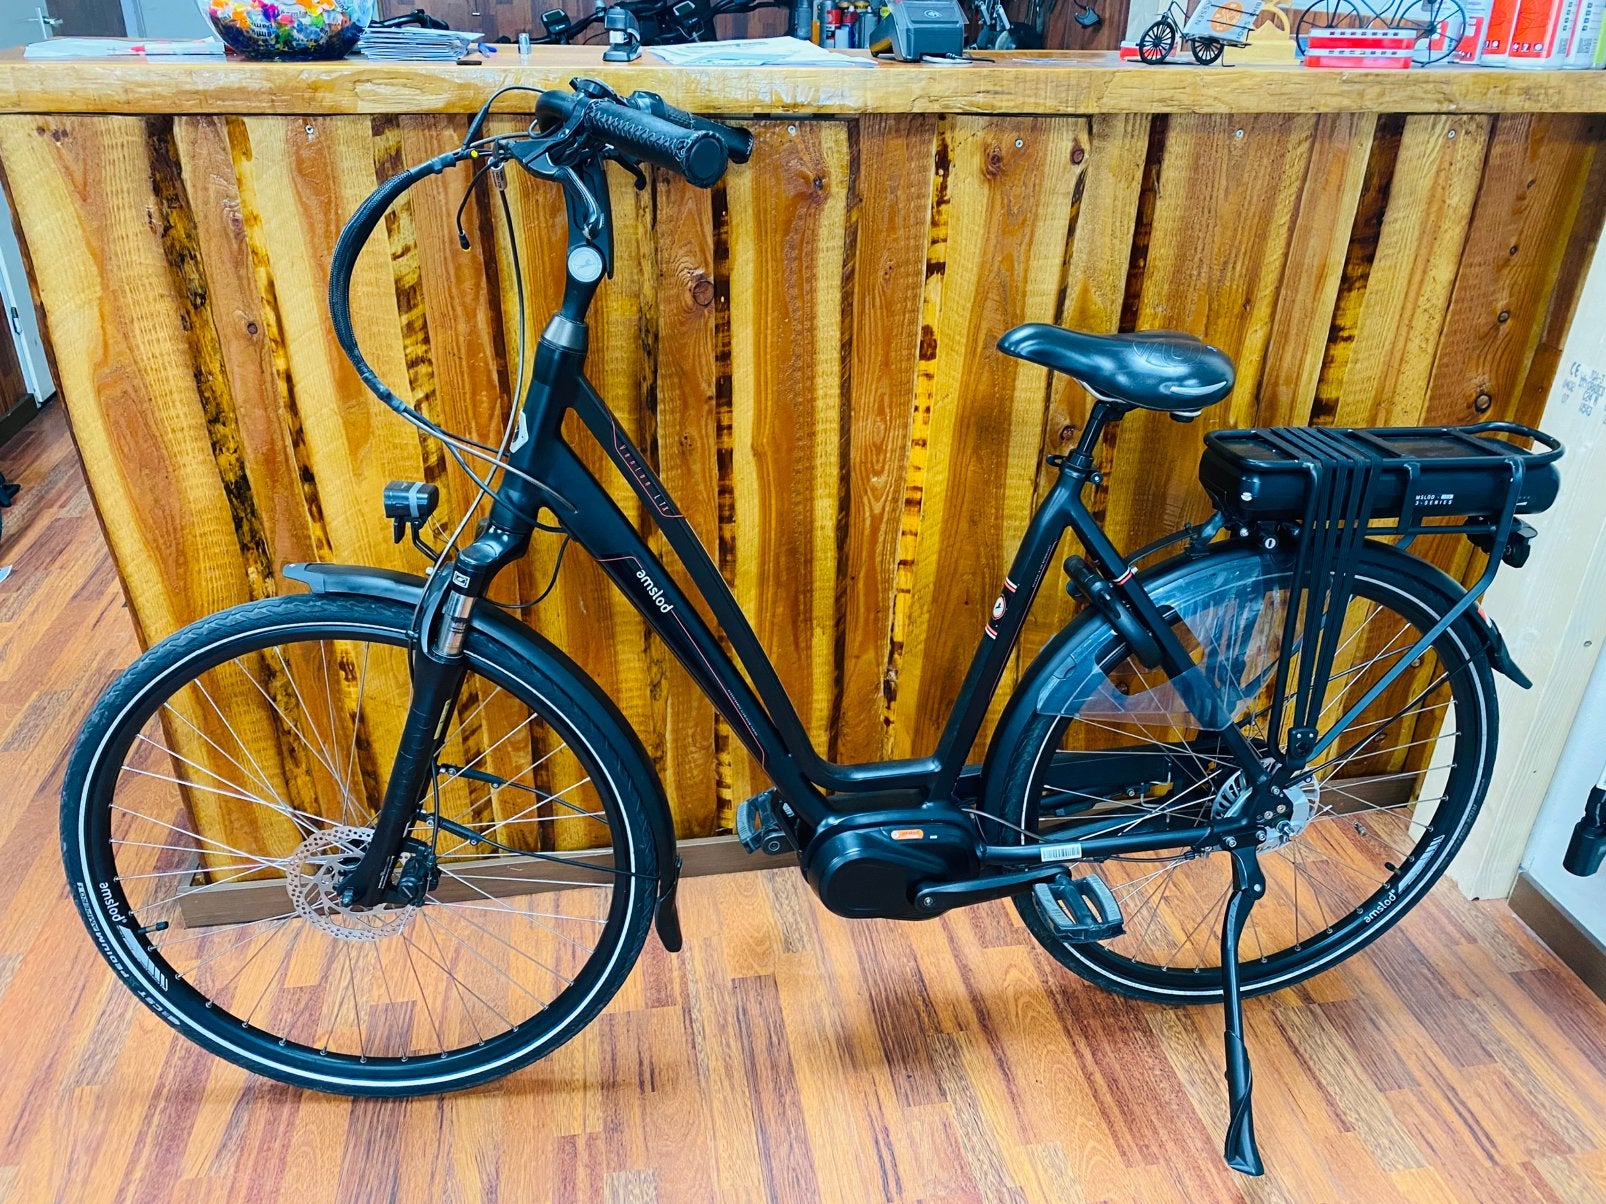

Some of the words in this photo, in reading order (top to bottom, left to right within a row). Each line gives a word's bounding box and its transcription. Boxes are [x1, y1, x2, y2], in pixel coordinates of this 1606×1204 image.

[636, 569, 674, 613] amslod
[99, 882, 125, 923] amslod
[1363, 890, 1397, 923] amslod
